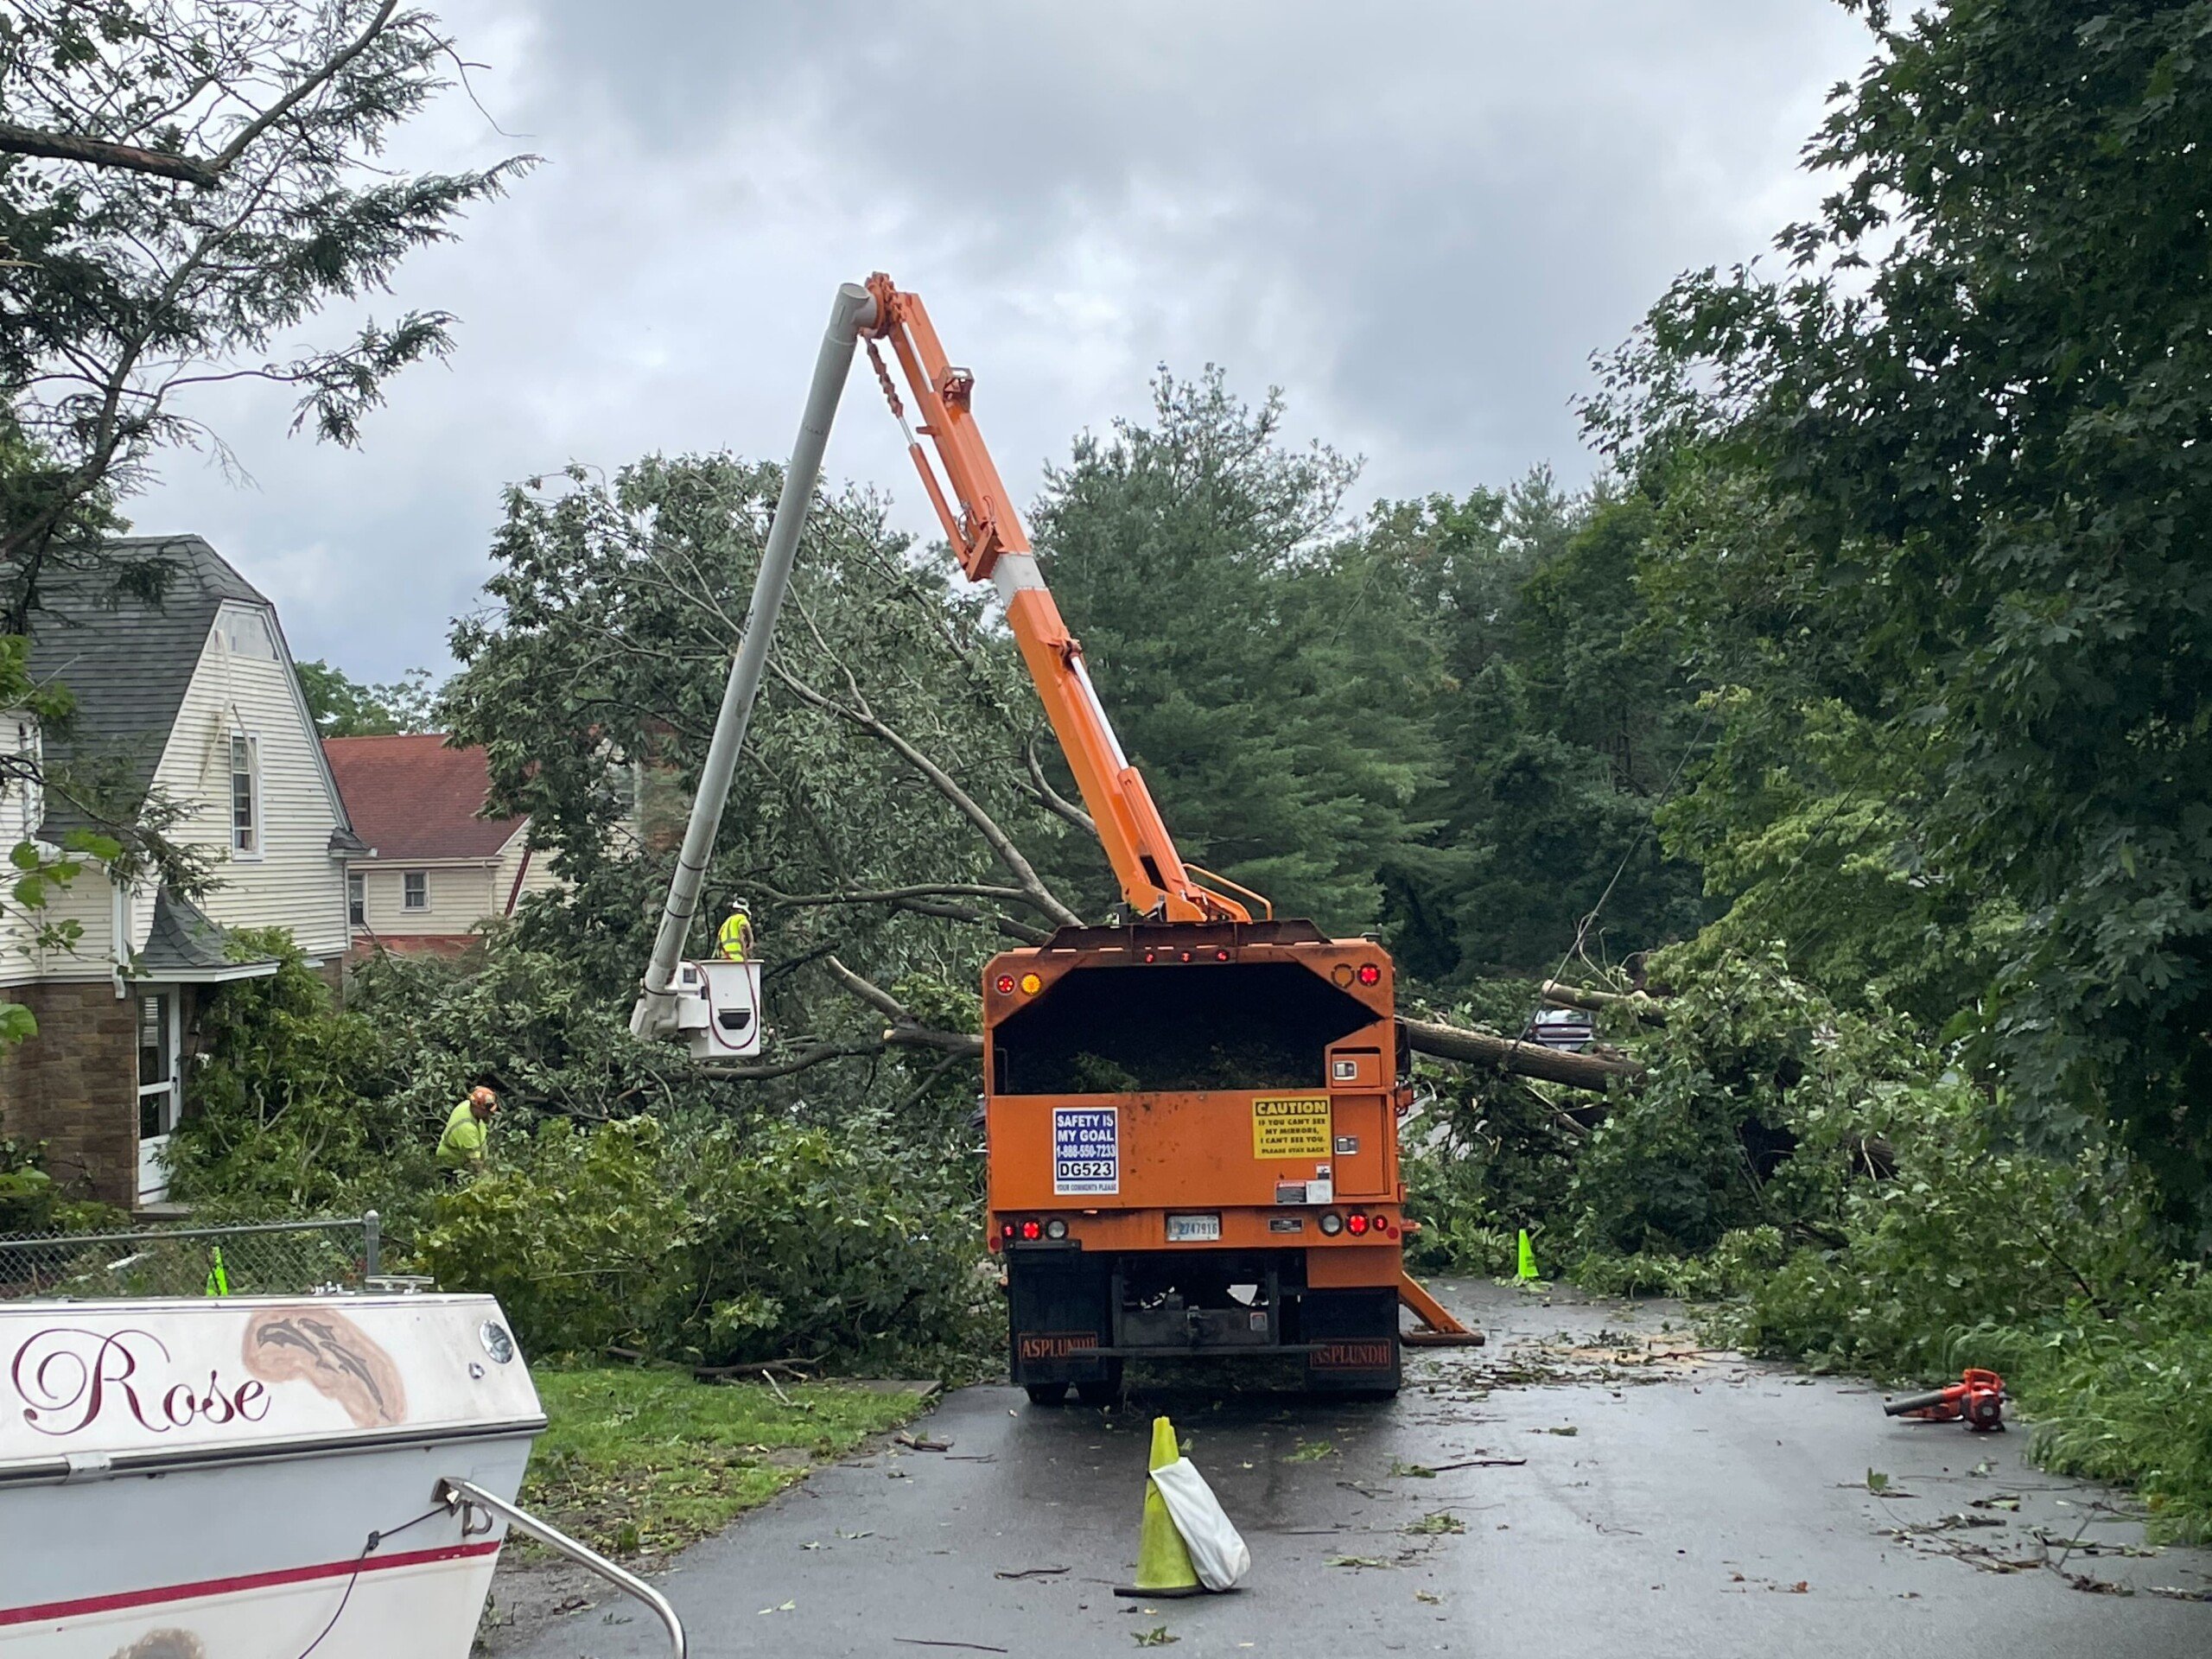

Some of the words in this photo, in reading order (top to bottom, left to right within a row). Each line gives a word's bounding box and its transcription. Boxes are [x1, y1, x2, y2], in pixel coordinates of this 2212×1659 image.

[1256, 1101, 1326, 1115] CAUTION
[1057, 1115, 1100, 1128] SAFETY
[1103, 1115, 1114, 1127] IS
[1057, 1129, 1077, 1142] MY
[1079, 1128, 1115, 1141] GOAL
[1060, 1162, 1112, 1176] DG523
[11, 1328, 271, 1436] Rose
